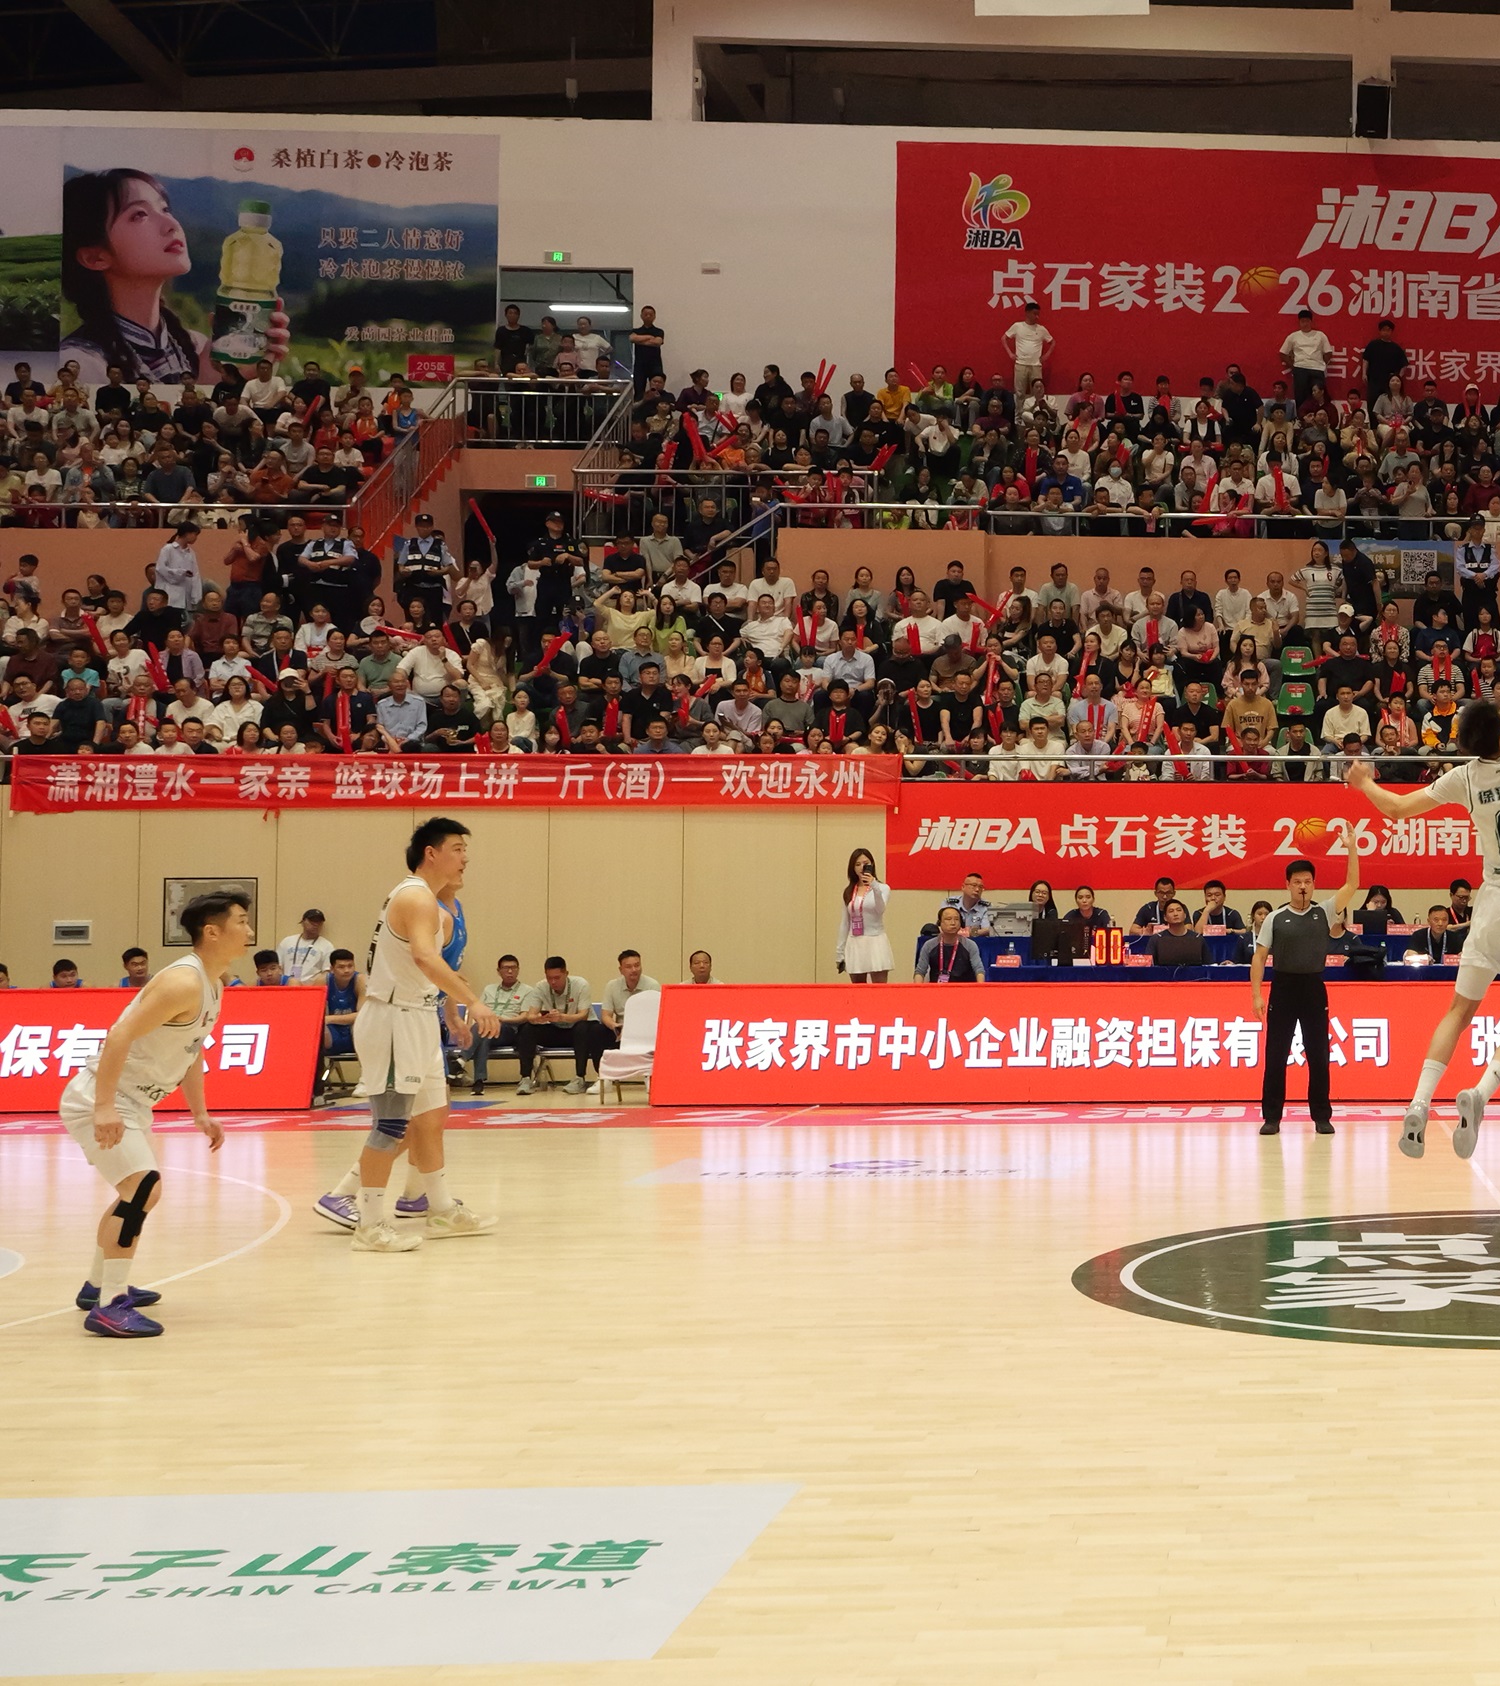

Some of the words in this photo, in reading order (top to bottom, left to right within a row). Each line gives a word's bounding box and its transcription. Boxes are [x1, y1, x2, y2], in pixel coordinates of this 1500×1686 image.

[318, 227, 465, 251] 只要二人情意好
[964, 228, 1023, 249] 湘BA
[319, 258, 466, 281] 冷水泡茶慢慢浓
[416, 361, 446, 371] 205区
[46, 762, 311, 803] 潇湘澧水一家亲
[908, 816, 1046, 856] 湘BA
[1056, 813, 1247, 859] 点石家装
[1, 1022, 270, 1077] 保有司
[126, 1583, 291, 1599] SHAN
[312, 1576, 632, 1595] CABLEWAY
